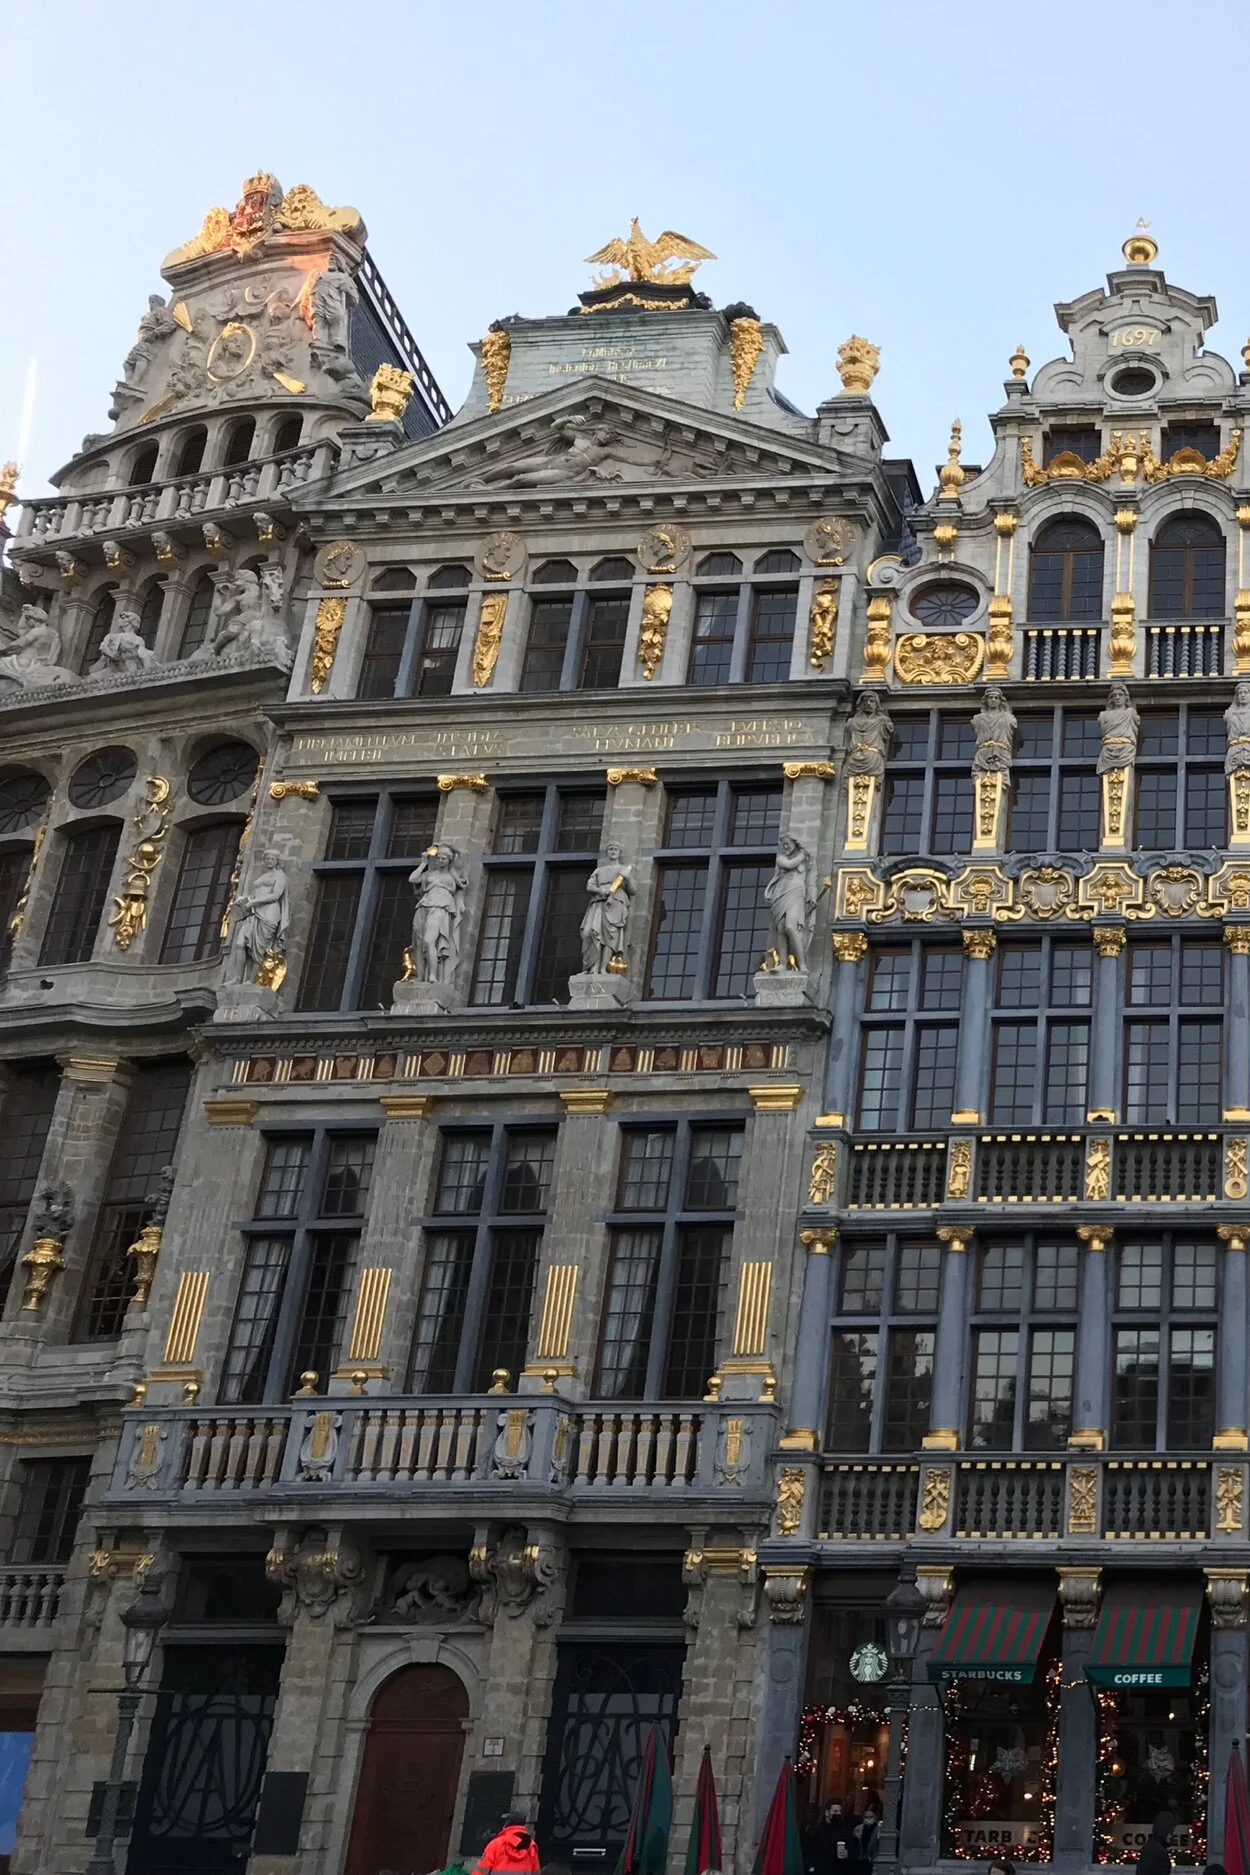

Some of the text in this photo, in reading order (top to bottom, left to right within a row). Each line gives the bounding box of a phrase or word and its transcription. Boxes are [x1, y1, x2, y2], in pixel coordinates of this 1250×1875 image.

[1111, 329, 1158, 347] 1697
[941, 1670, 1022, 1680] STARBUCKS
[1114, 1674, 1163, 1683] COFFEE
